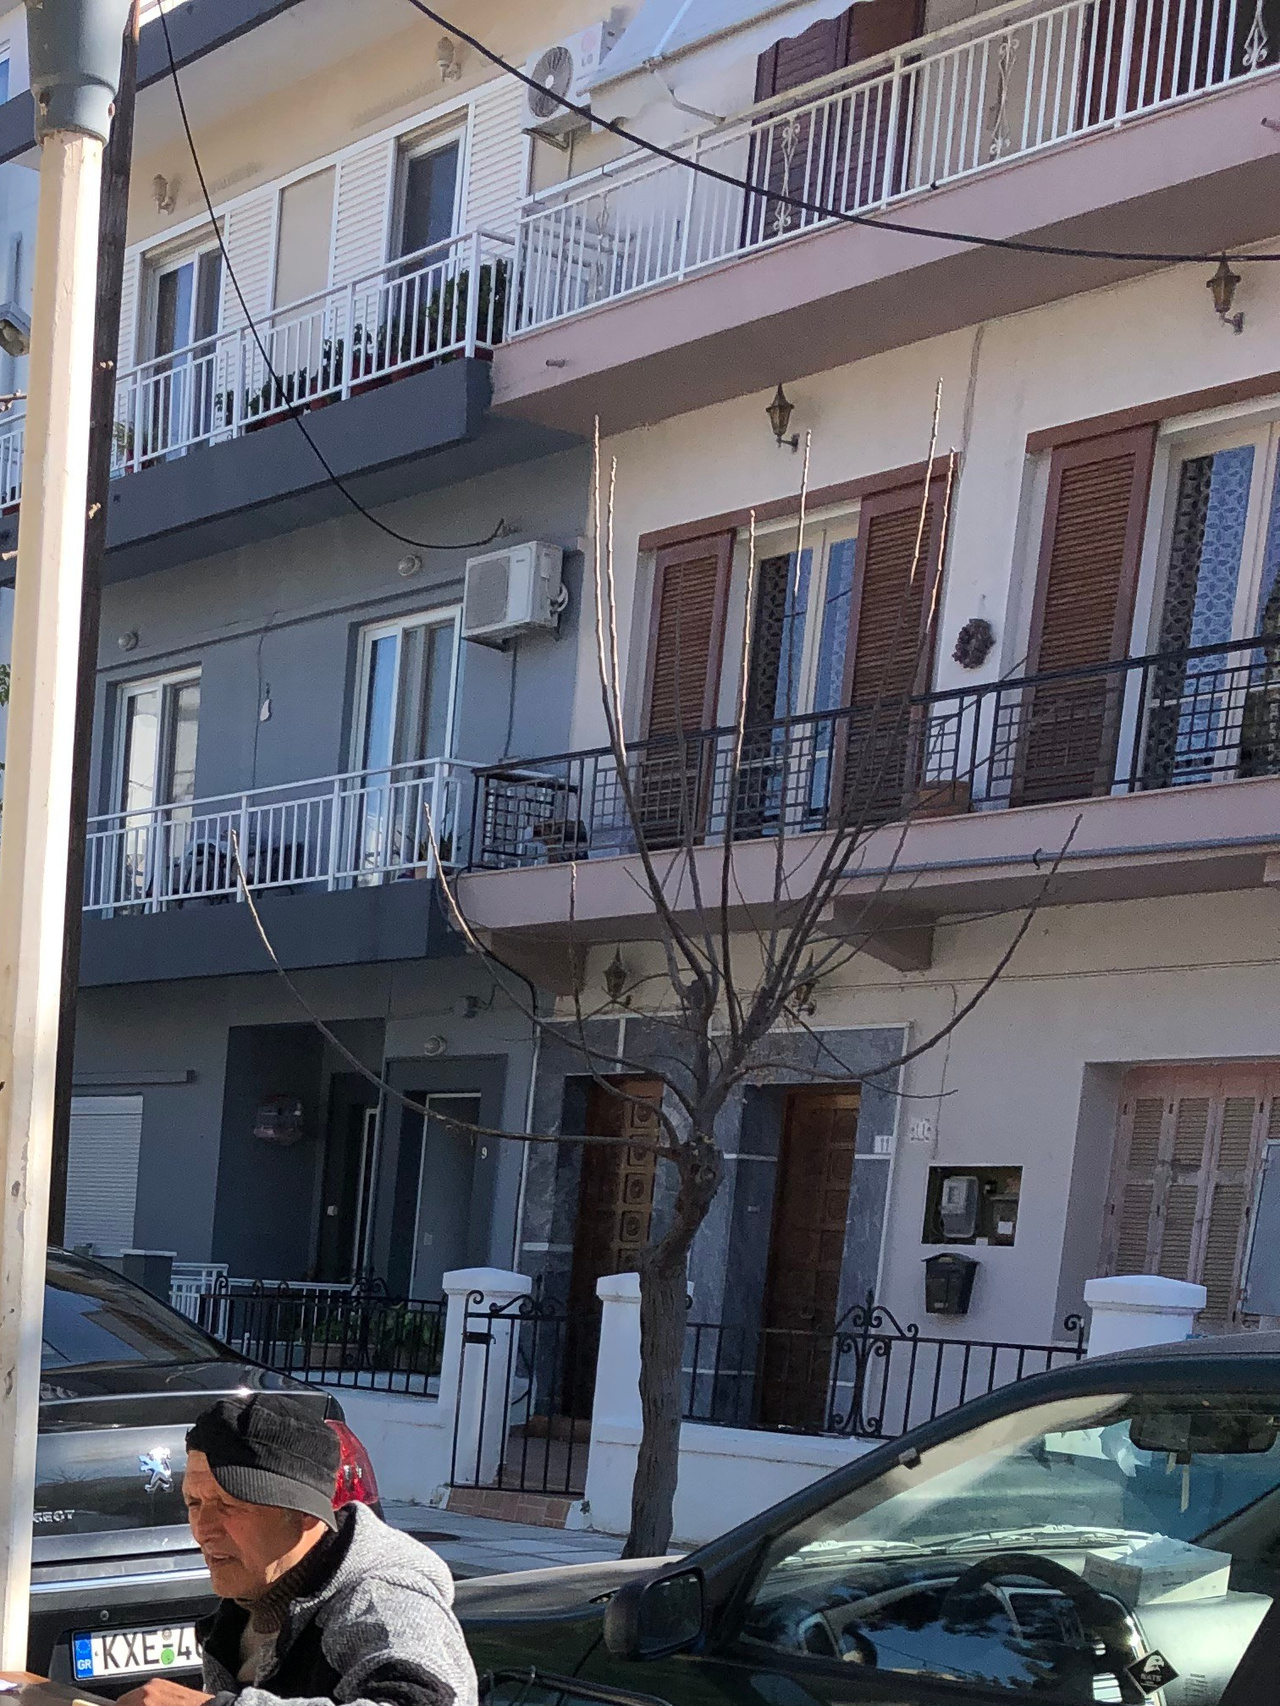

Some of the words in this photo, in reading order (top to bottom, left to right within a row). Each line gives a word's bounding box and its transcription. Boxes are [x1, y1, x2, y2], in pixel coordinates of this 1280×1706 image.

[880, 1137, 889, 1152] 11
[481, 1146, 488, 1160] 9
[32, 1509, 76, 1523] GEOT
[77, 1659, 92, 1671] GR
